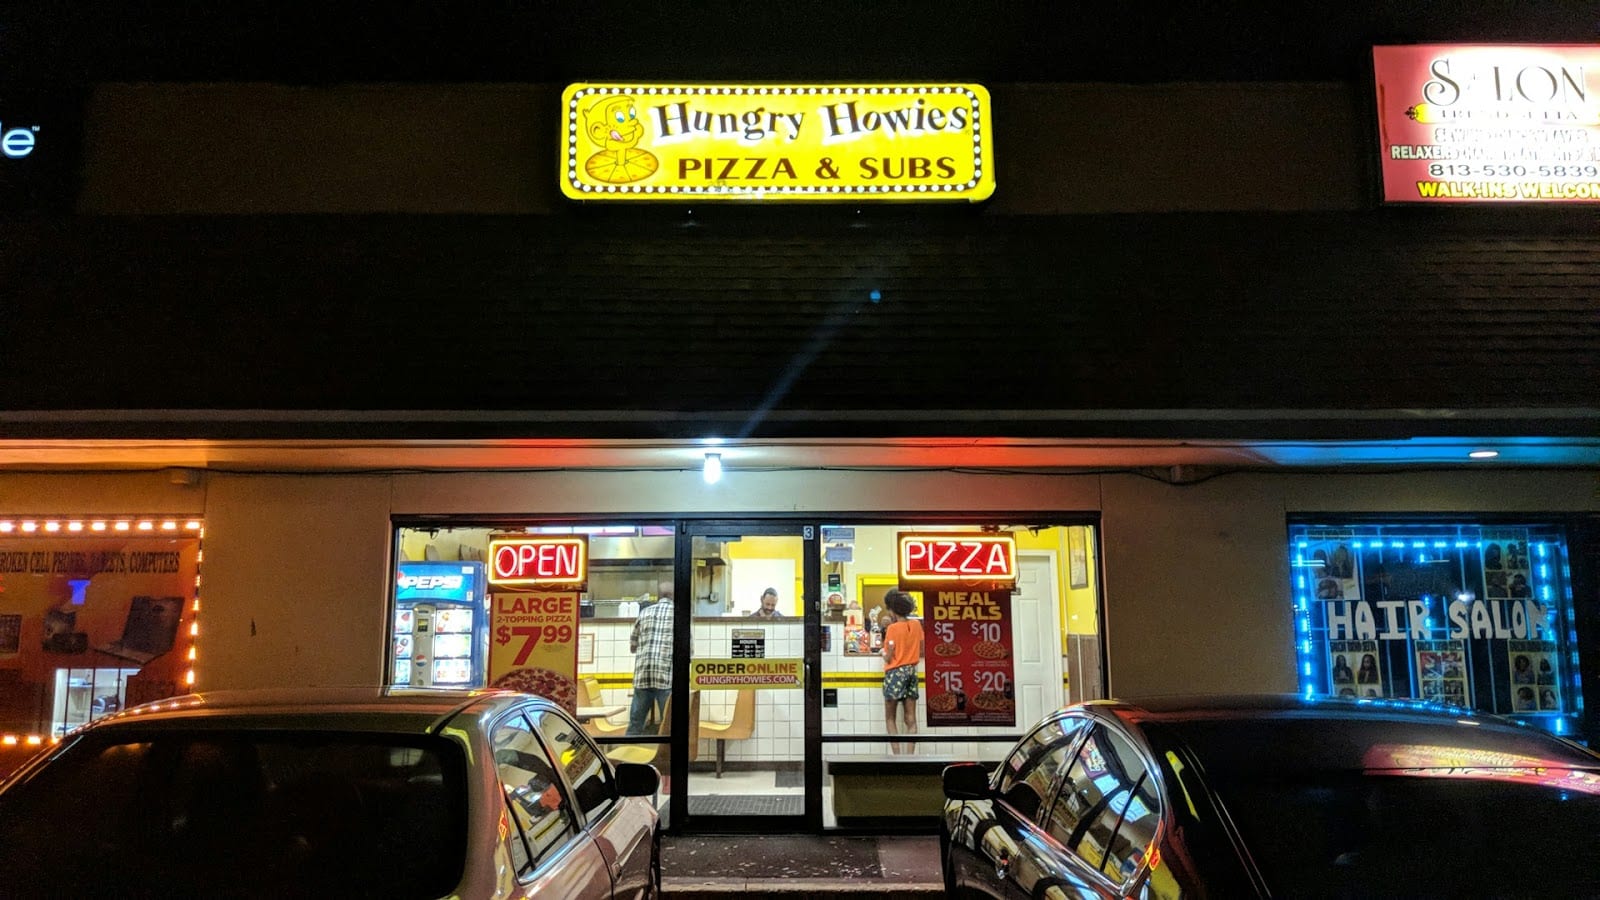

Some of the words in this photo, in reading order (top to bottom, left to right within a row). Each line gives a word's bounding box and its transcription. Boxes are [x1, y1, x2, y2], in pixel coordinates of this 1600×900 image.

[1424, 58, 1586, 106] SLON
[654, 101, 805, 141] Hungry
[824, 98, 968, 137] Howies
[1391, 145, 1459, 160] RELAXE
[678, 157, 798, 180] PIZZA
[815, 157, 840, 180] &
[859, 156, 957, 180] SUBS
[1429, 164, 1598, 177] 813-530-5839
[1417, 181, 1518, 199] WALK-INS
[804, 526, 813, 539] 3
[30, 551, 49, 573] CELL
[130, 551, 180, 573] COMPUTERS
[495, 544, 578, 577] OPEN
[905, 541, 1008, 574] PIZZA
[498, 597, 572, 614] LARGE
[938, 591, 996, 606] MEAL
[496, 615, 544, 623] 2-TOPPING
[933, 606, 1002, 621] DEALS
[1327, 600, 1432, 640] HAIR
[1449, 600, 1548, 640] SALON
[934, 621, 955, 643] $5
[971, 621, 1001, 643] $10
[698, 675, 795, 685] HUNGRYHOWIES.COM
[933, 670, 963, 693] $15
[973, 670, 1007, 692] $20
